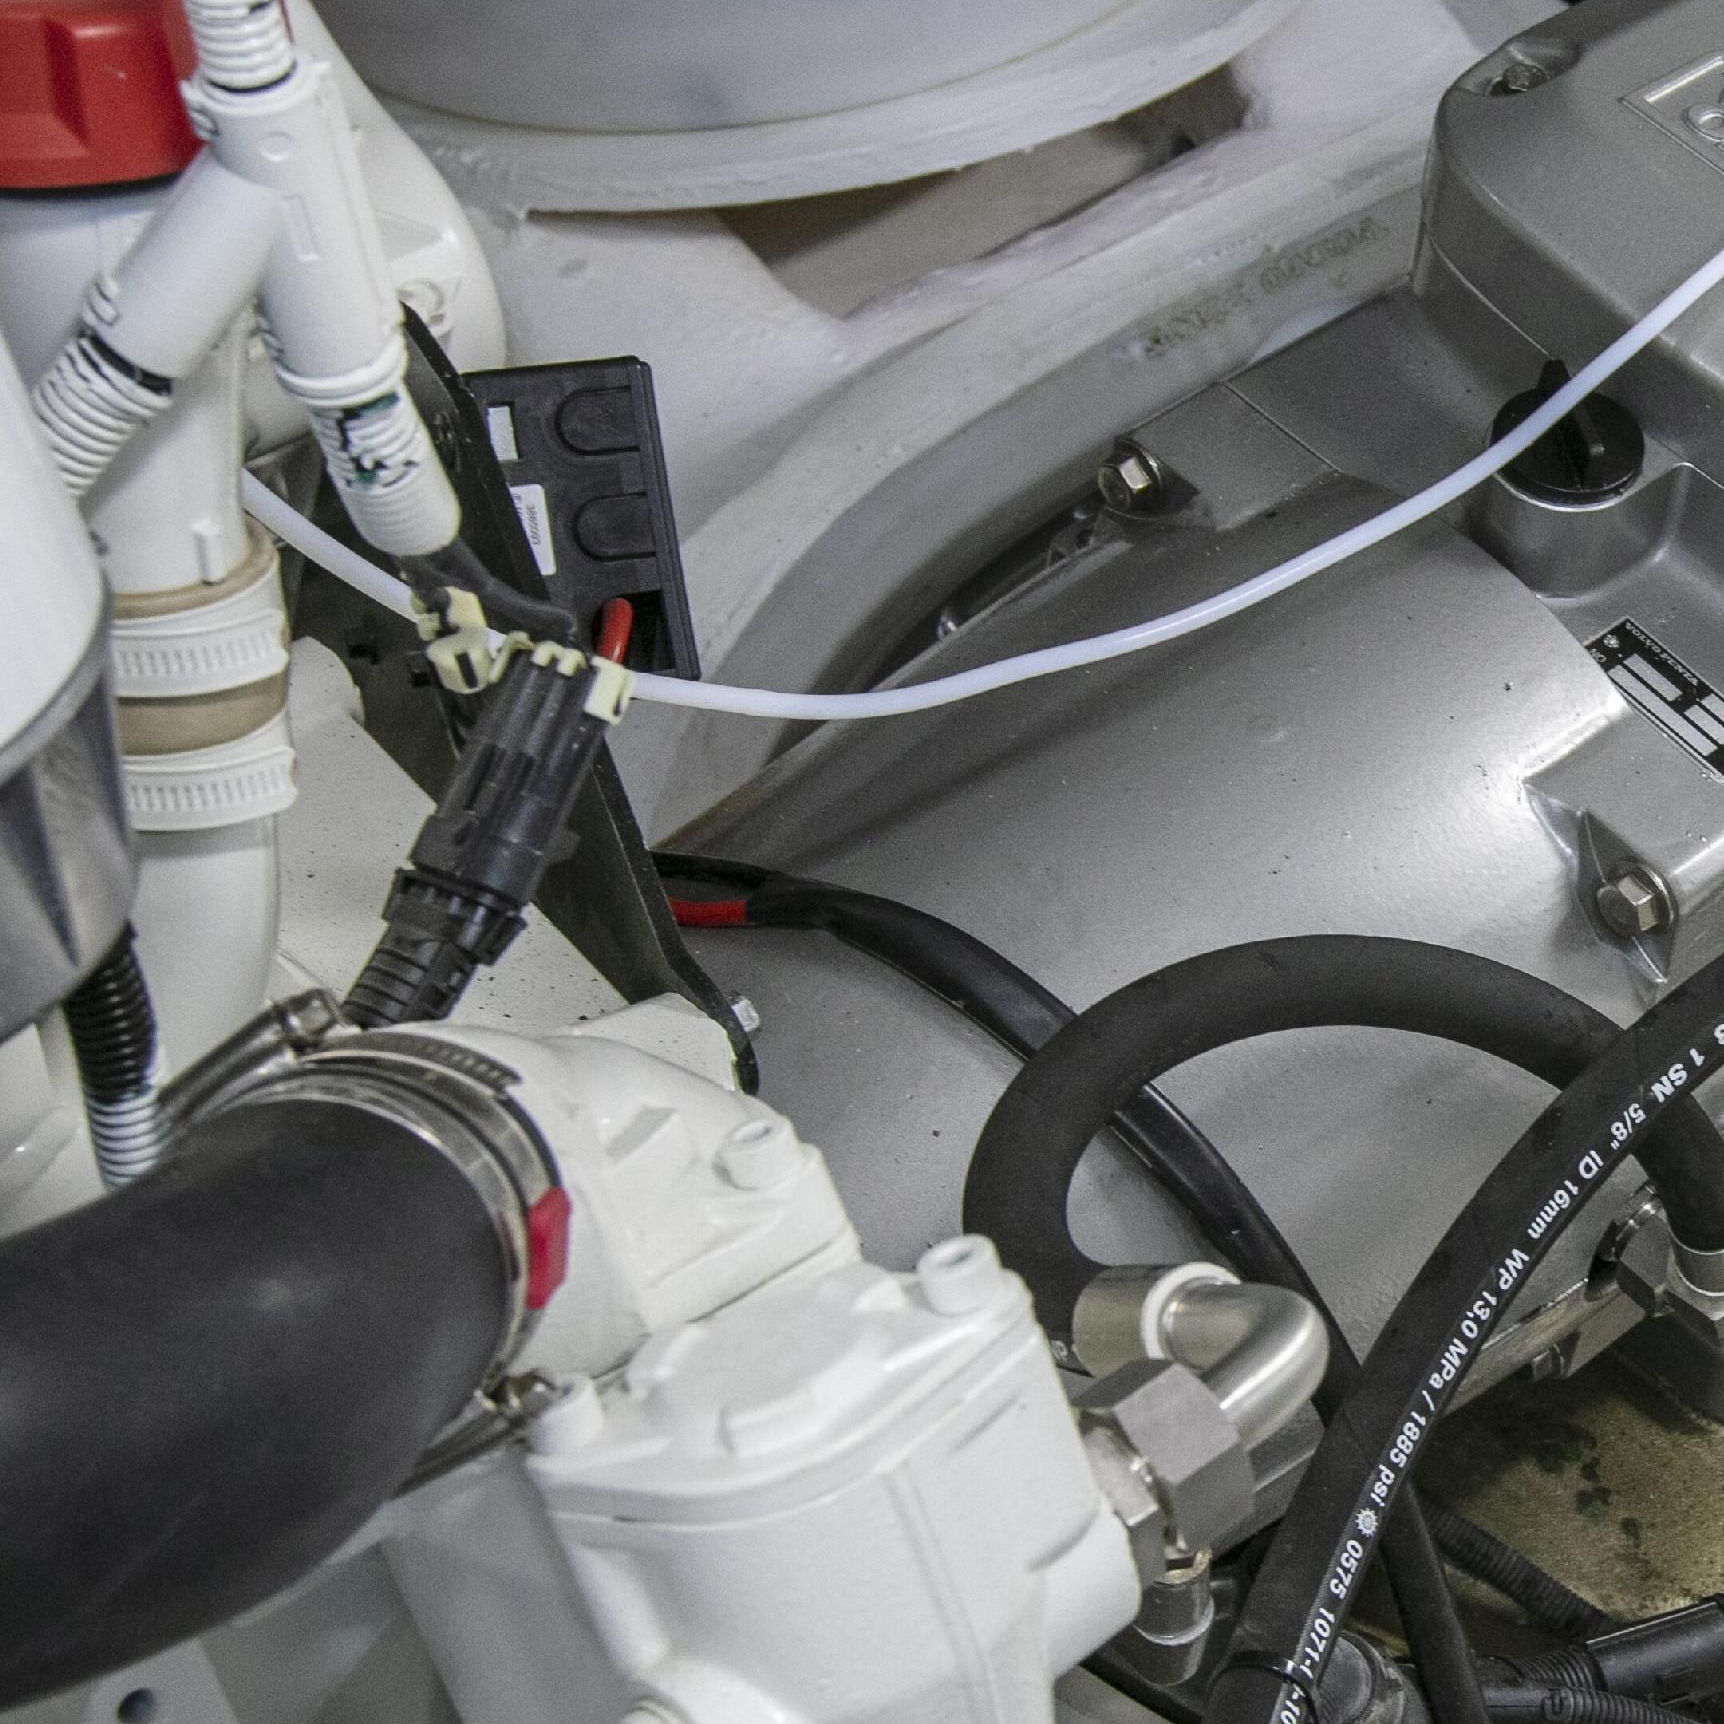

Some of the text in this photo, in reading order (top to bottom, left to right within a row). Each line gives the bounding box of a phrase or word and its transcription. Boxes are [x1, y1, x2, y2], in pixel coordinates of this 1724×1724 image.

[1624, 620, 1699, 686] VOLVO PENTA
[1689, 1048, 1705, 1067] 1
[1650, 1063, 1688, 1103] SN
[1610, 1103, 1647, 1151] 5/8"
[1578, 1150, 1605, 1179] ID
[1526, 1179, 1580, 1239] 16mm
[1498, 1248, 1531, 1291] WP
[1461, 1290, 1498, 1329] 13,0
[1429, 1337, 1469, 1389] MPa
[1421, 1390, 1436, 1412] /
[1389, 1411, 1427, 1469] 1885
[1370, 1464, 1396, 1508] psi
[1330, 1539, 1364, 1600] 0575
